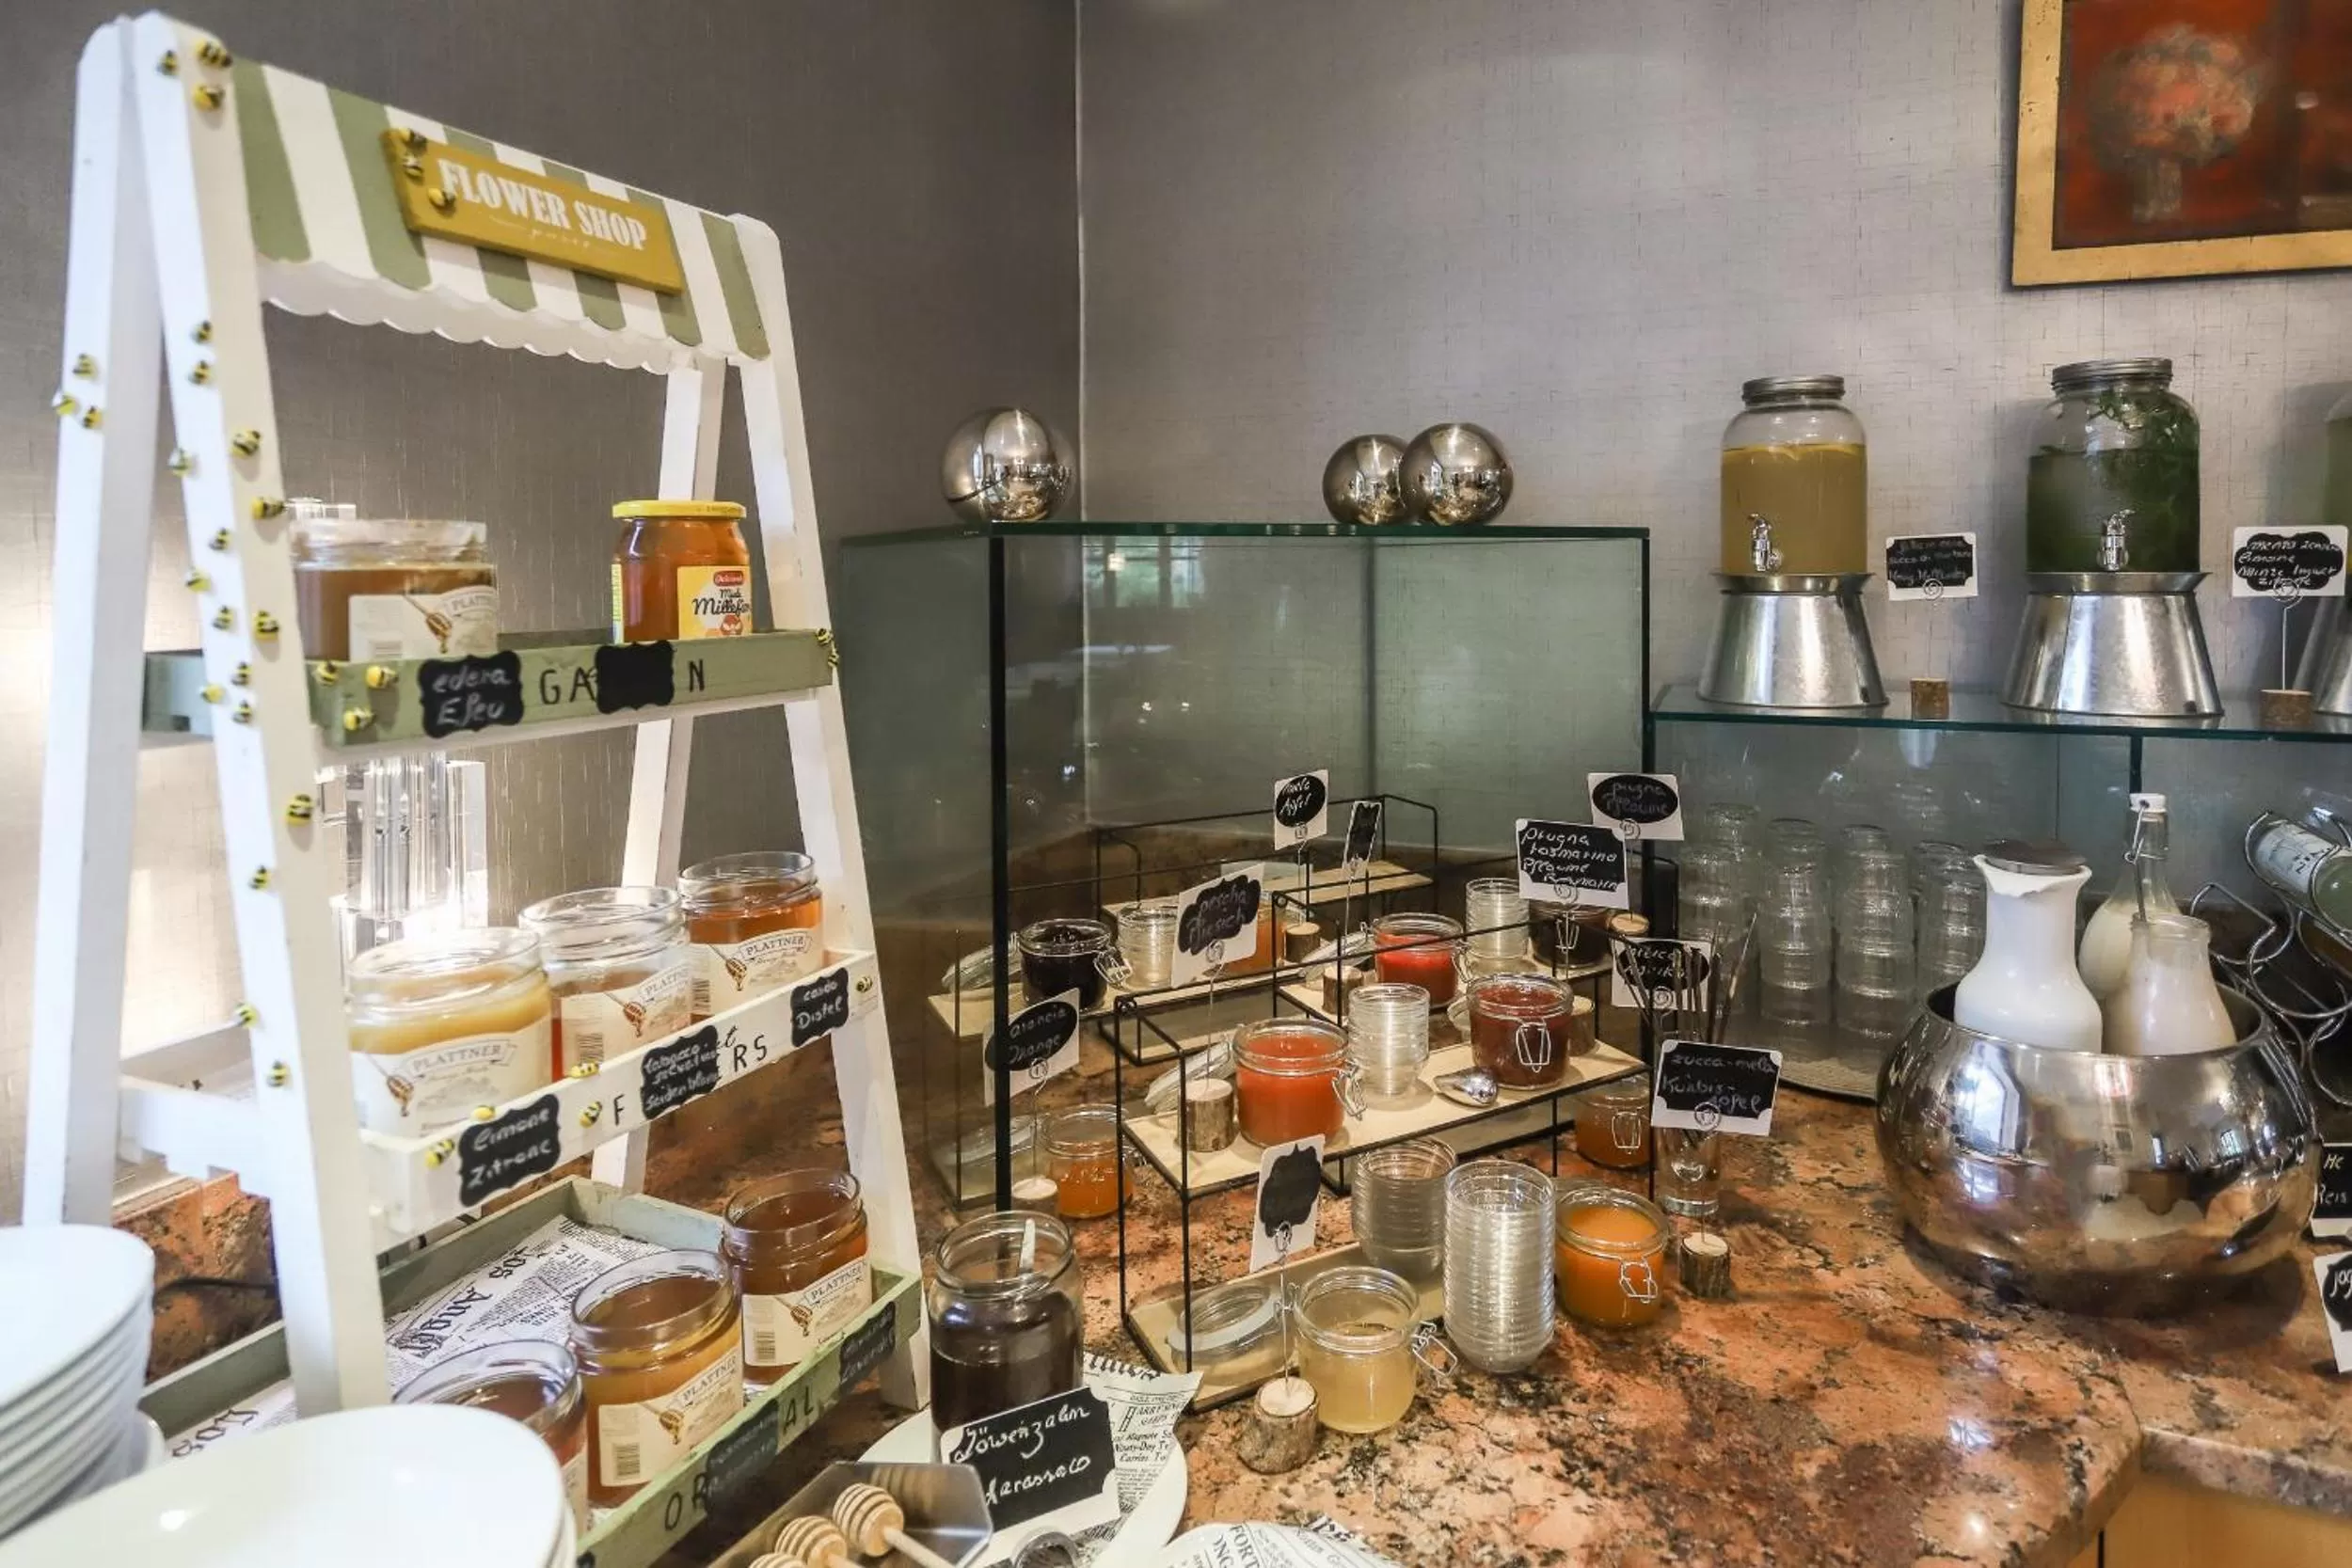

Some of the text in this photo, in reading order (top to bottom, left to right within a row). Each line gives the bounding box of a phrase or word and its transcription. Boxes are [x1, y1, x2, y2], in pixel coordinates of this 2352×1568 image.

[437, 158, 648, 251] FLOWER SHOP
[1520, 827, 1590, 848] prugna
[796, 995, 843, 1030] Distel
[413, 1044, 501, 1070] PLATTNER
[468, 1139, 552, 1188] Zitrone
